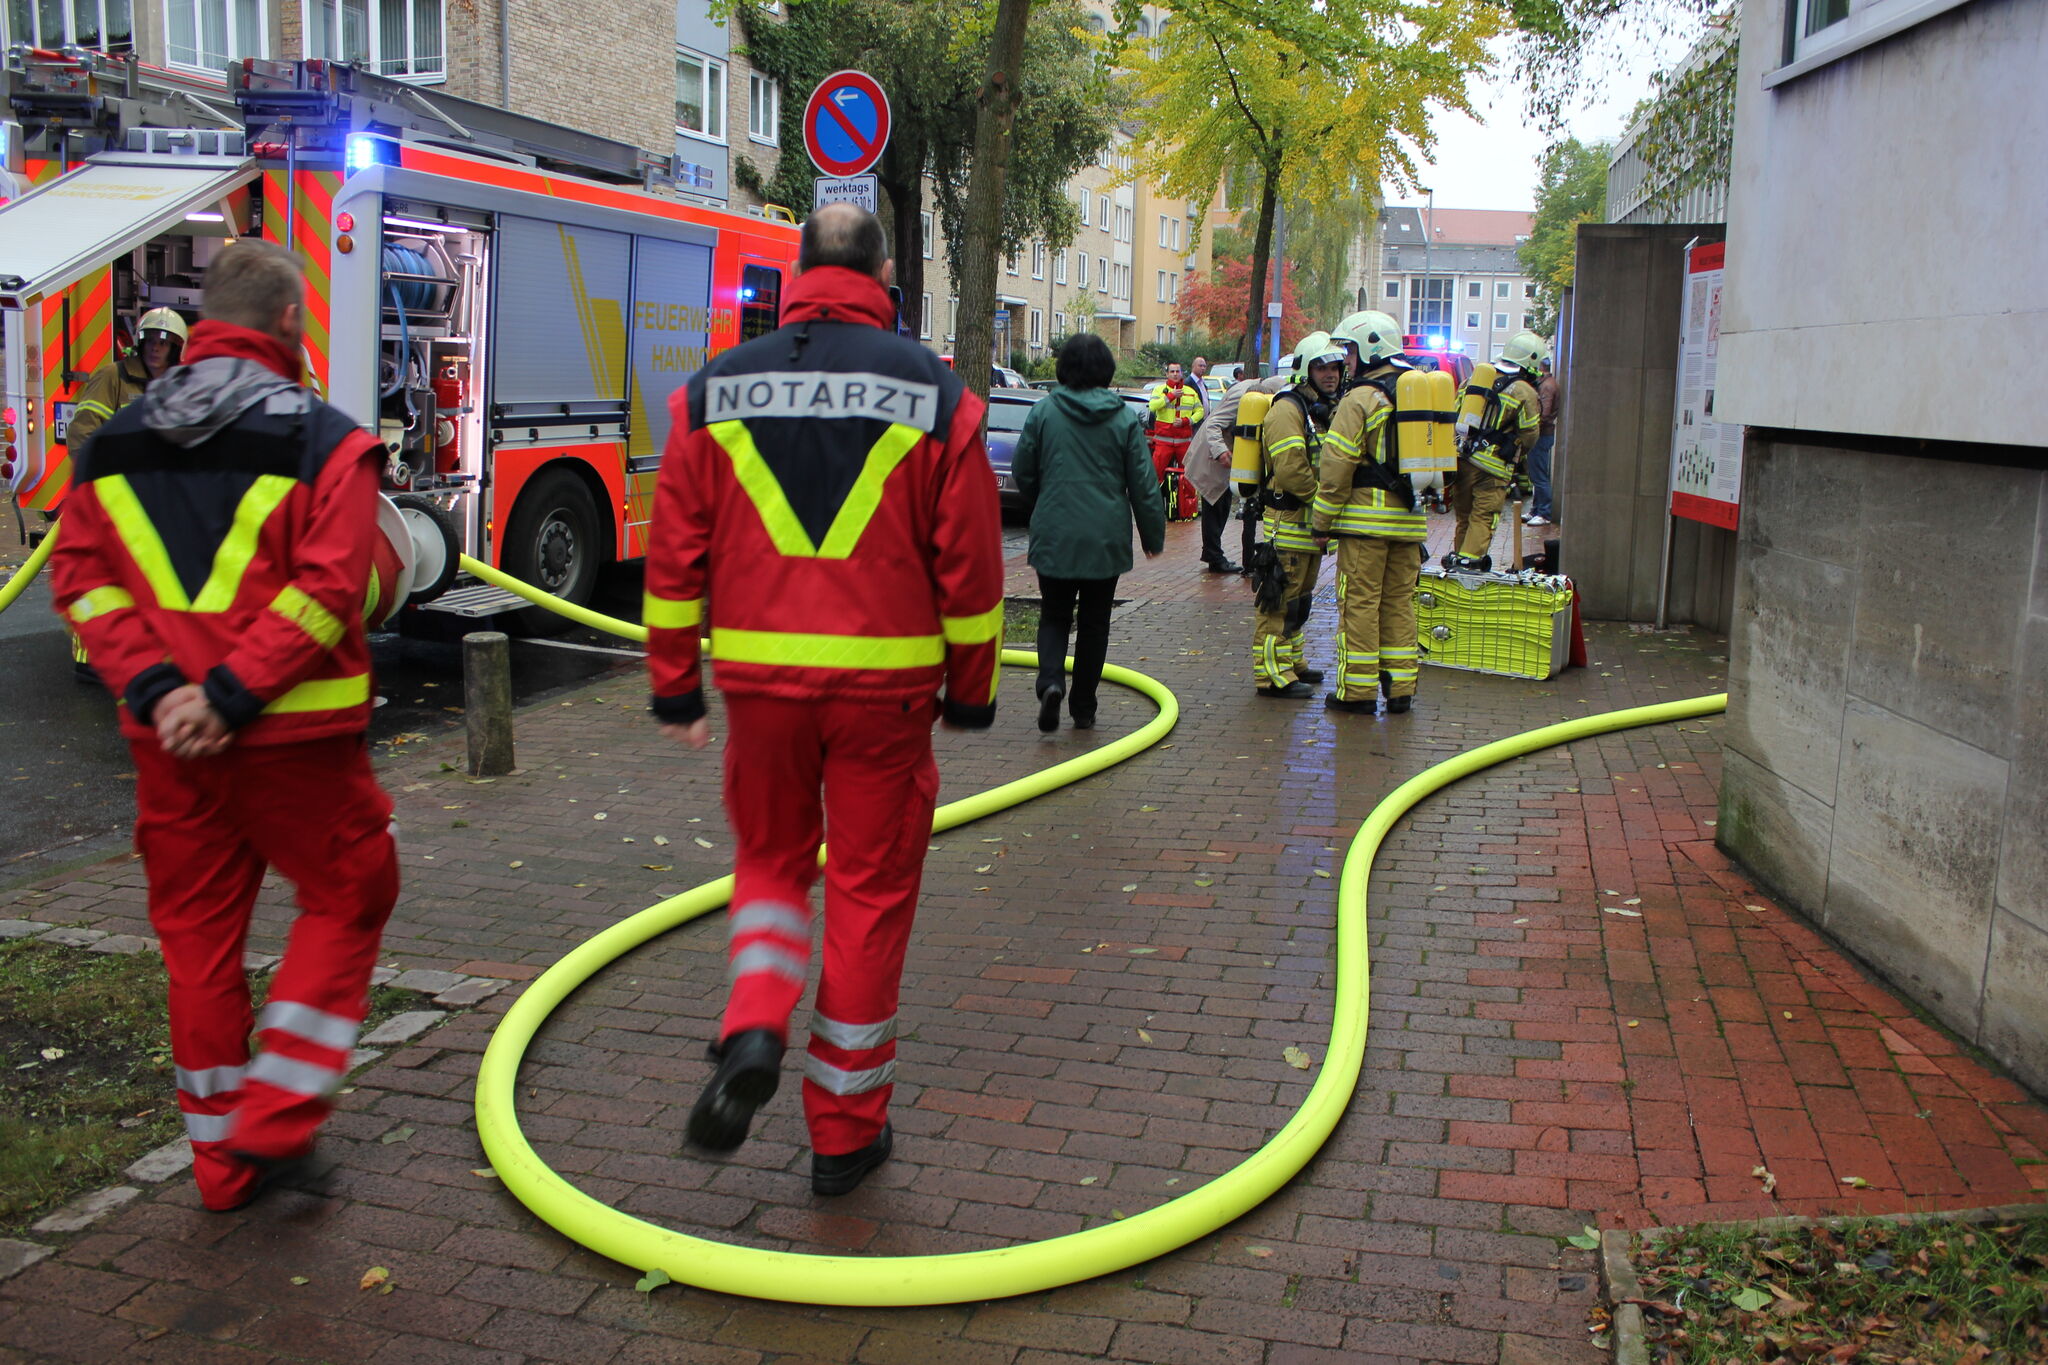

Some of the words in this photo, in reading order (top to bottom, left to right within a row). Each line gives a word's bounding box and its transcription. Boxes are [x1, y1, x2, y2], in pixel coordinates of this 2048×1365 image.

[825, 183, 869, 195] werktags
[635, 301, 732, 334] FEUERWEHR
[717, 381, 926, 419] NOTARZT
